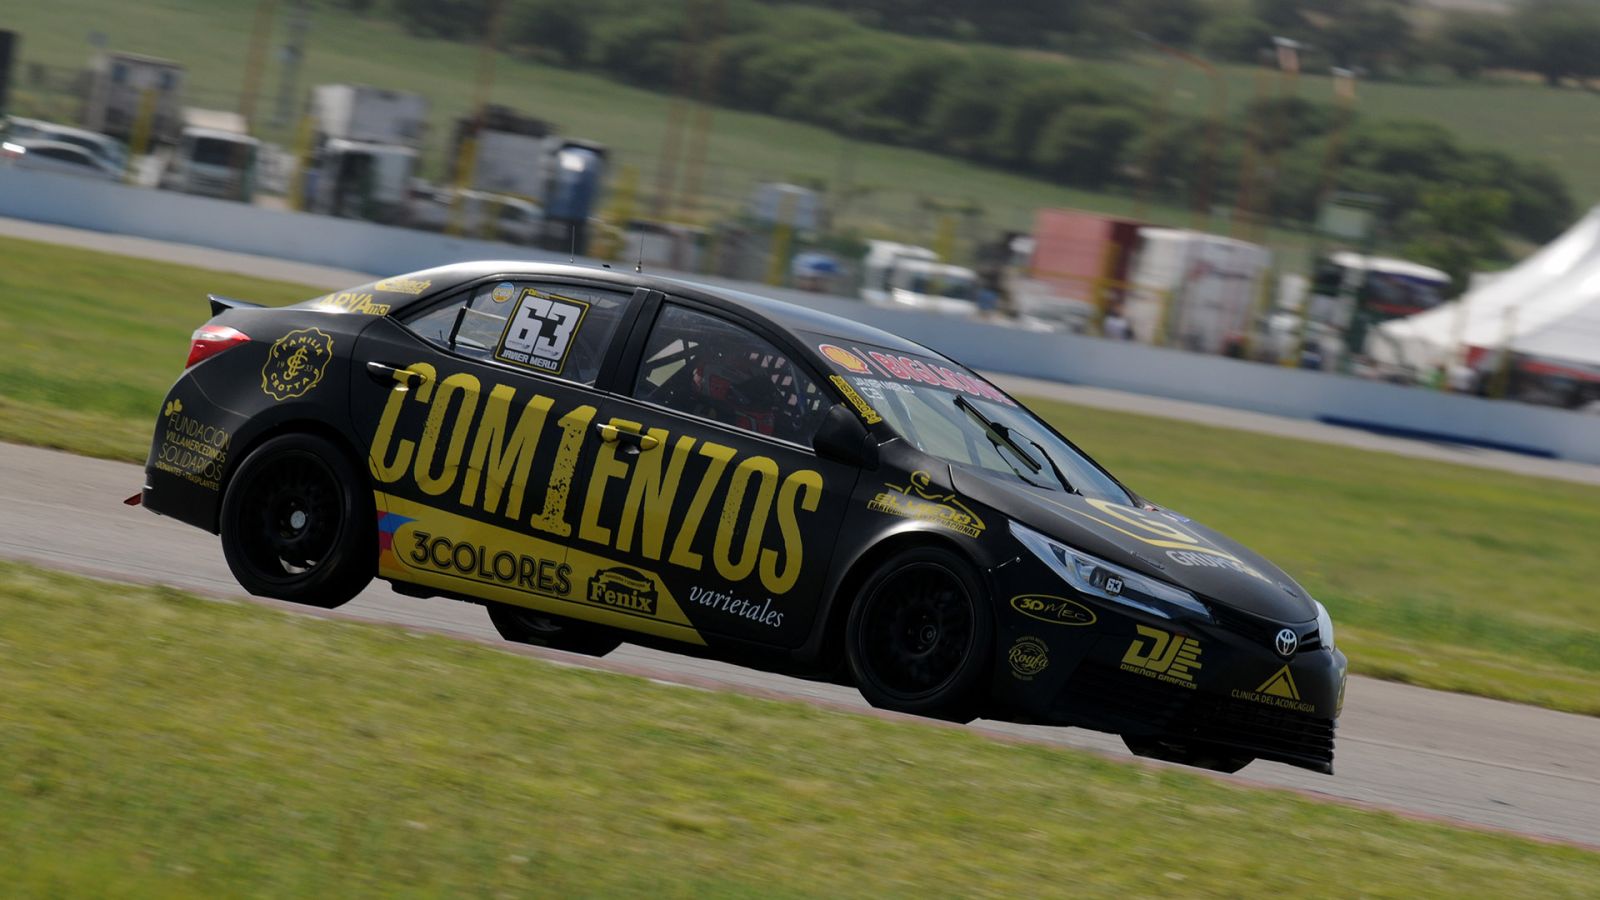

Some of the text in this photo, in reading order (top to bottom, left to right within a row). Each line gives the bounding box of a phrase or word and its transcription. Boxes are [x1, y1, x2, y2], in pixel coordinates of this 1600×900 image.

[505, 296, 581, 361] 63
[281, 336, 324, 356] FAMILIA
[501, 349, 529, 363] JAVIER
[530, 356, 558, 371] MERLO
[270, 372, 310, 392] CROTTA
[168, 412, 233, 450] FUNDACIÓN
[158, 442, 223, 480] SOLIDARIOS
[368, 361, 824, 595] COM1ENZOS
[410, 530, 573, 596] 3COLORES
[590, 581, 652, 612] Fenix
[1106, 577, 1122, 593] 63
[689, 586, 785, 627] varietales
[1231, 688, 1316, 713] CLINICA DEL ACONCAGUA
